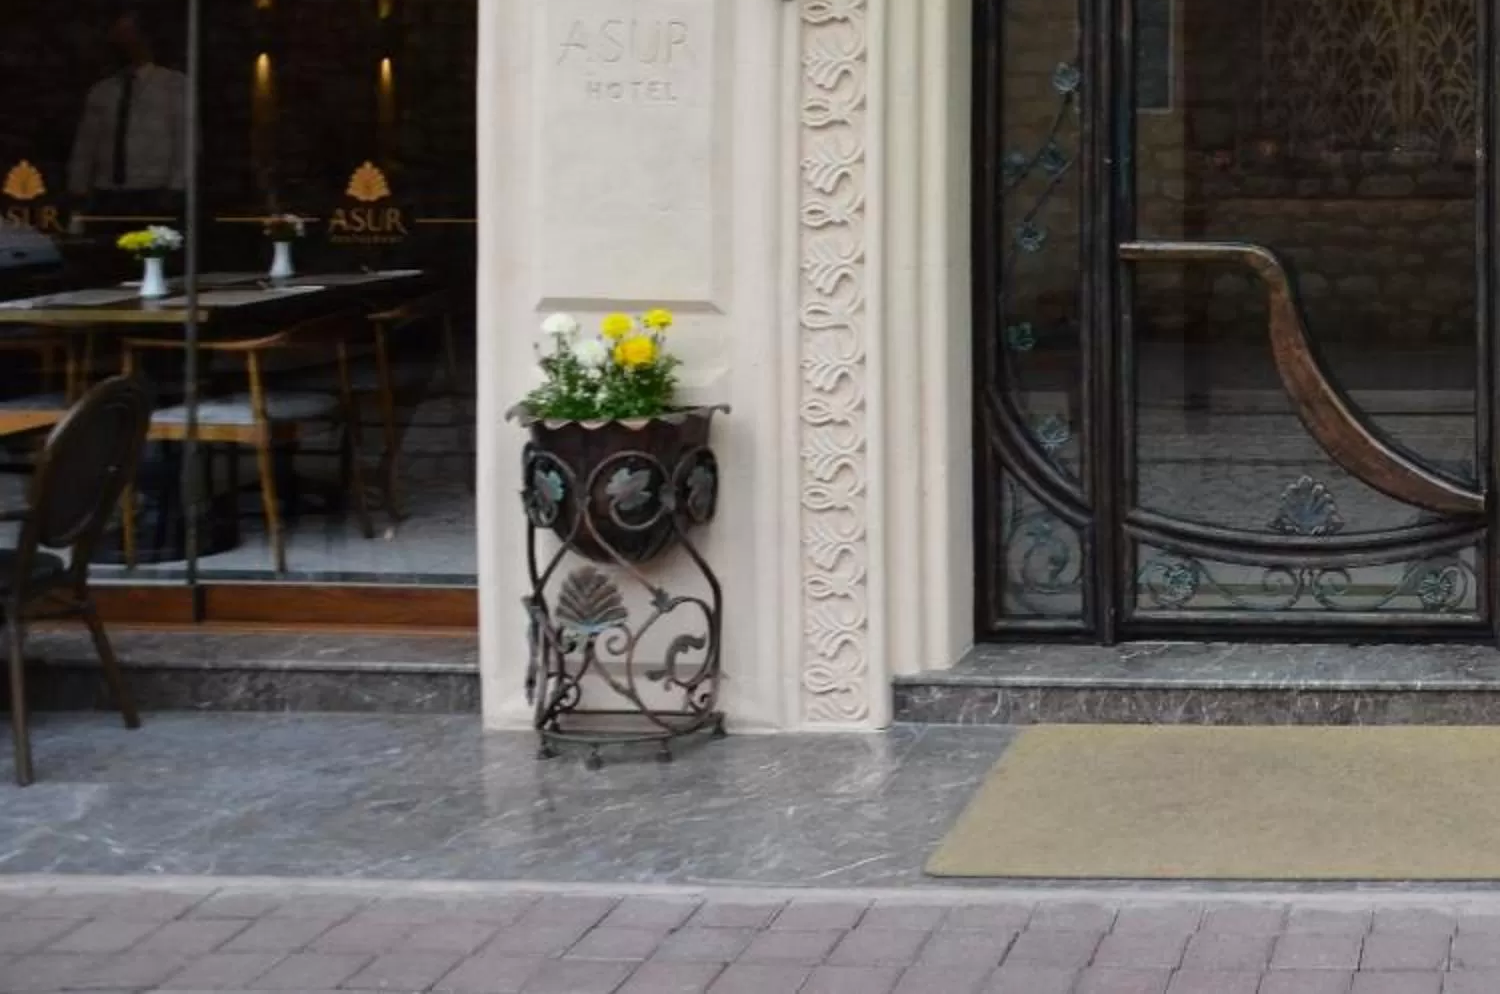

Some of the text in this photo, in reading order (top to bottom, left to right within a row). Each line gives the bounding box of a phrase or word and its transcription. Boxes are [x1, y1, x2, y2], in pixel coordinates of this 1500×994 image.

[556, 18, 697, 66] ASUR
[584, 79, 680, 103] HOTEL
[328, 206, 409, 234] ASUR
